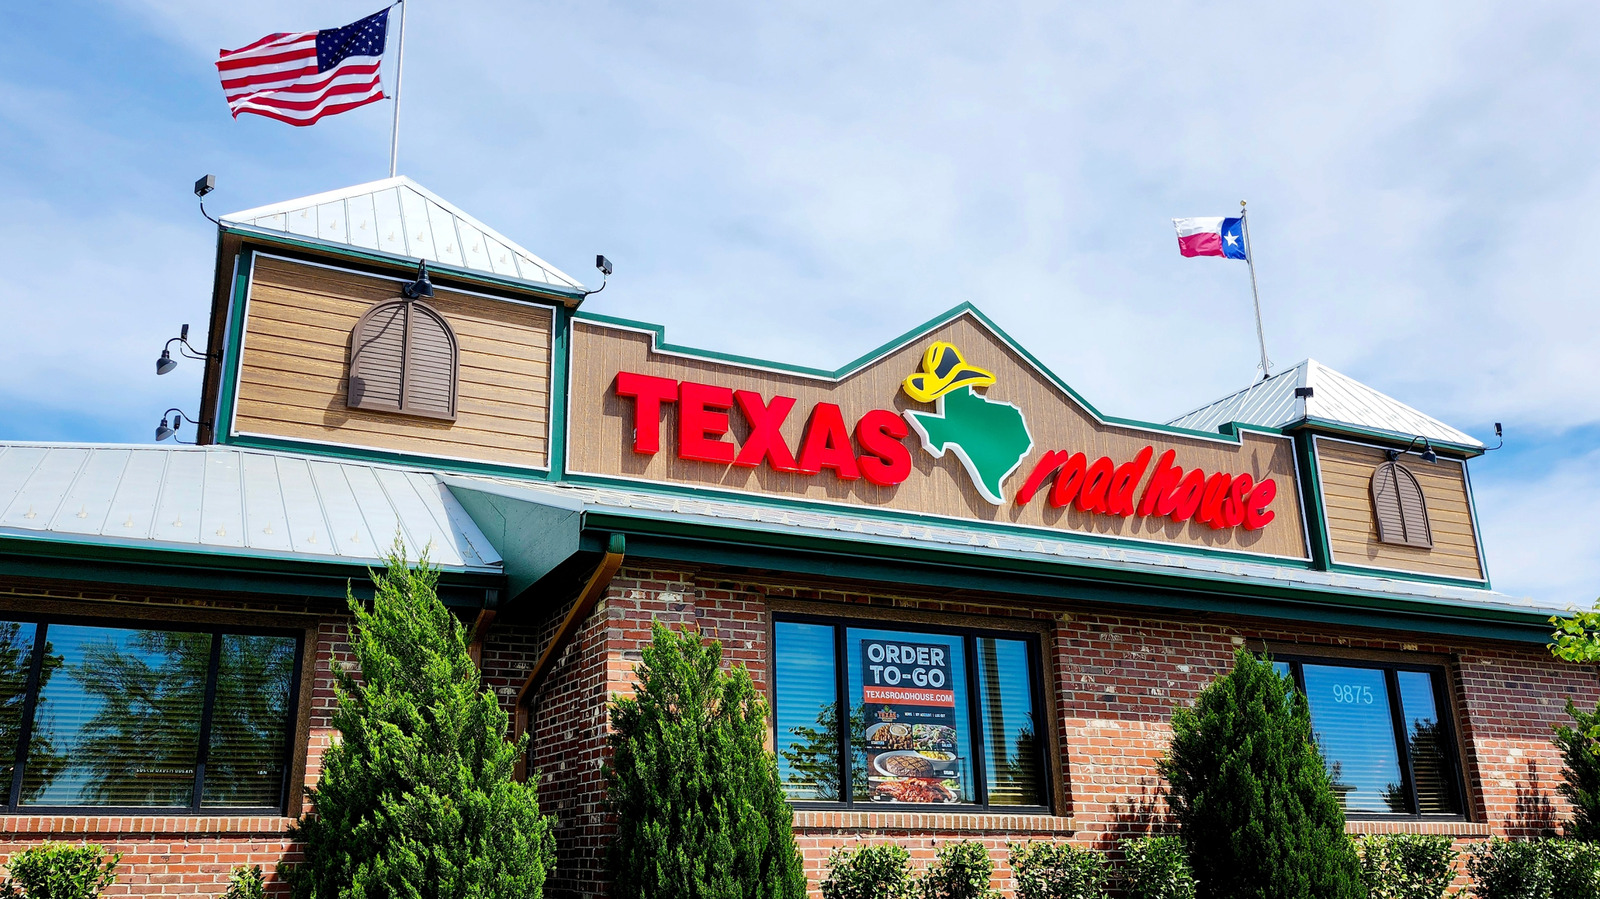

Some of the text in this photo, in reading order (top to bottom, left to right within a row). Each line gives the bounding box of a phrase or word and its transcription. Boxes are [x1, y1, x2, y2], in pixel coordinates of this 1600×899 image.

[615, 371, 913, 487] TEXAS
[867, 643, 945, 667] ORDER
[869, 665, 945, 688] TO-GO
[866, 690, 953, 702] TEXASROADHOUSE.COM
[1332, 683, 1374, 705] 9875
